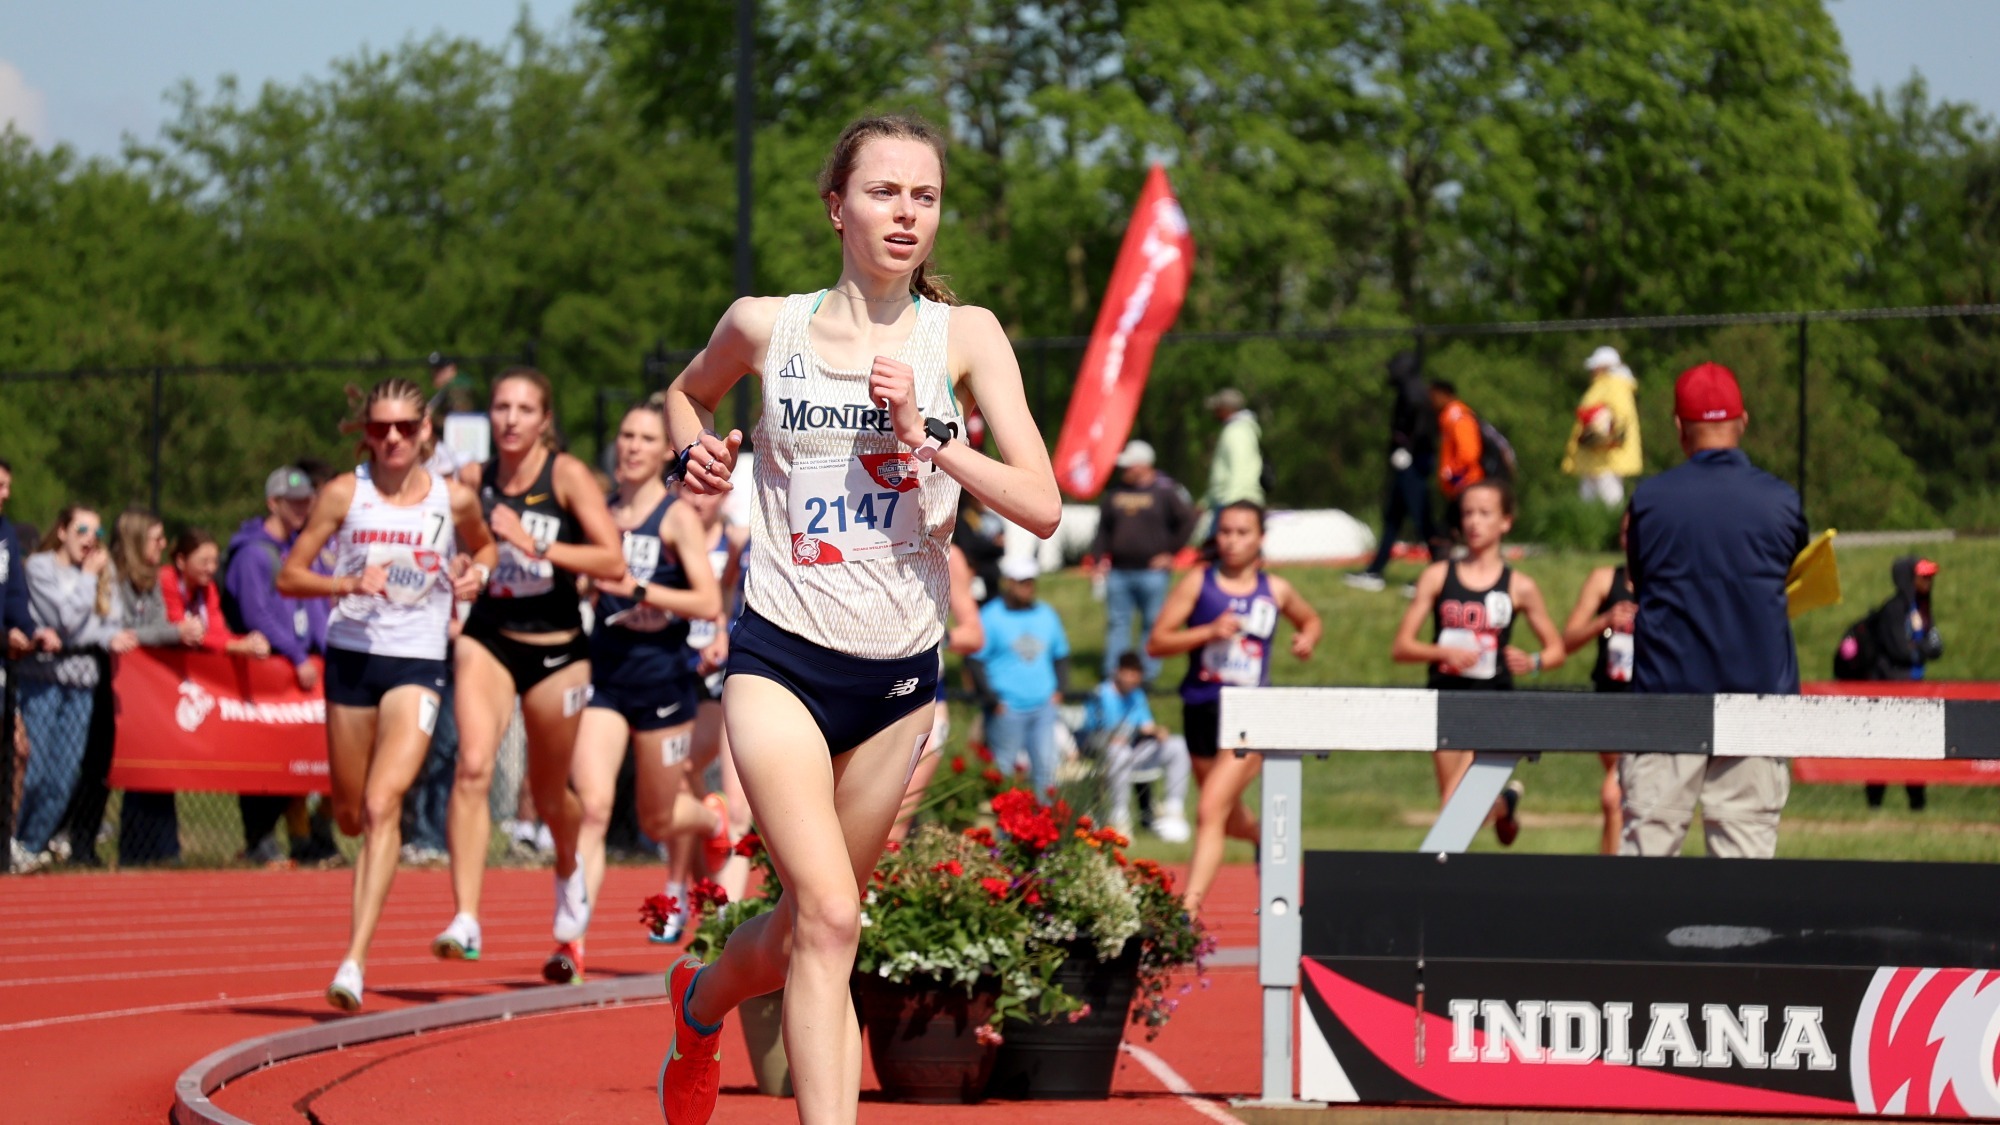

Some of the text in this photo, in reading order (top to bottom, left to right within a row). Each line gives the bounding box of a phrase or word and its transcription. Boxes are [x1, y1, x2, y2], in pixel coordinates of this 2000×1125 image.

[800, 438, 894, 449] COLLEGE
[804, 491, 900, 535] 2147
[352, 530, 423, 545] CUMBERLA
[432, 513, 445, 545] 7
[217, 697, 326, 724] MARINE
[1449, 999, 1836, 1070] INDIANA
